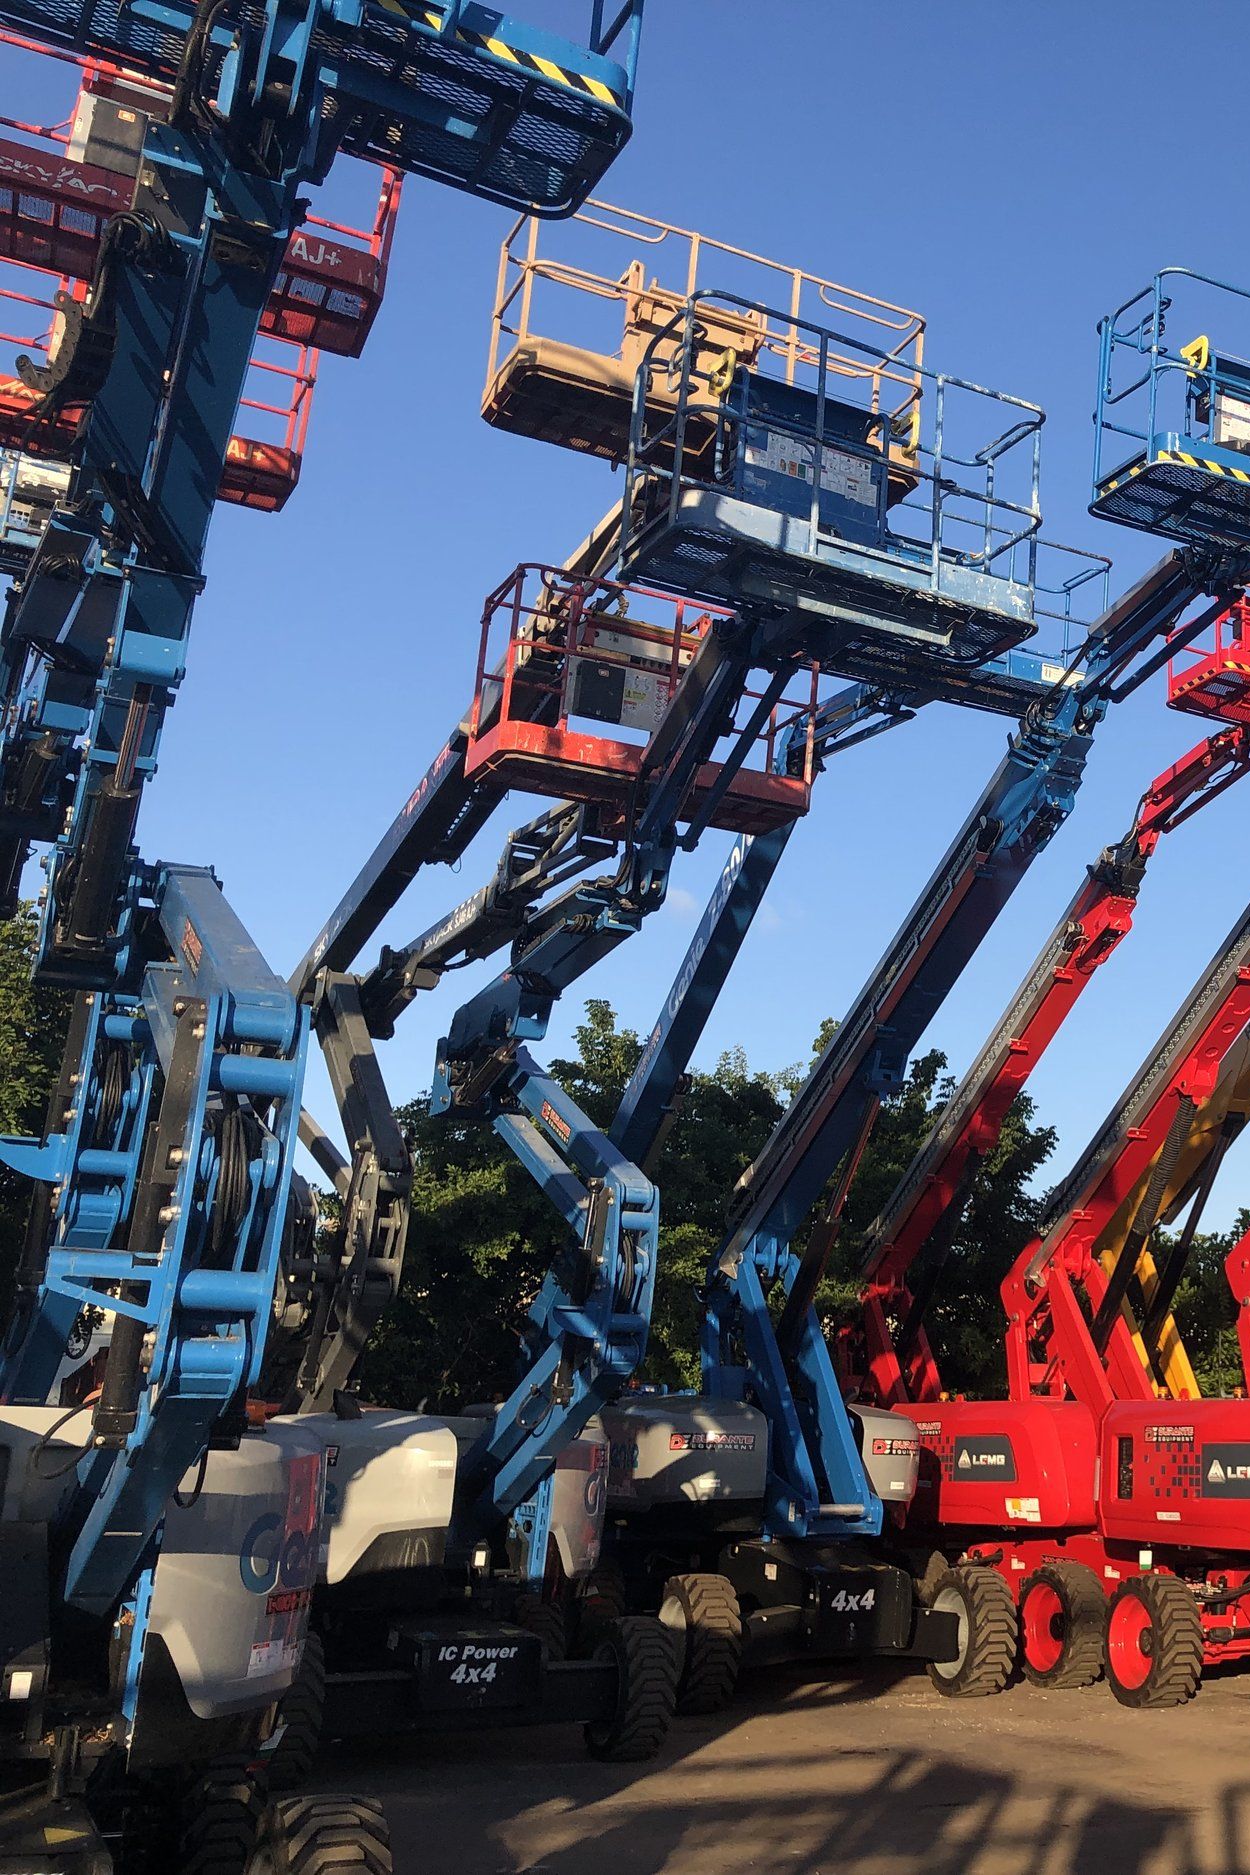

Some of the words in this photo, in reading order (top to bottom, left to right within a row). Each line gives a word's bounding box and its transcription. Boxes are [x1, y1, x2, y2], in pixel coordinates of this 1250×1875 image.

[291, 238, 342, 266] AJ+
[668, 936, 706, 1020] Genie
[691, 1434, 755, 1444] DURANTE
[831, 1589, 875, 1612] 4x4
[438, 1646, 458, 1661] IC
[461, 1645, 518, 1660] Power
[450, 1662, 497, 1684] 4x4
